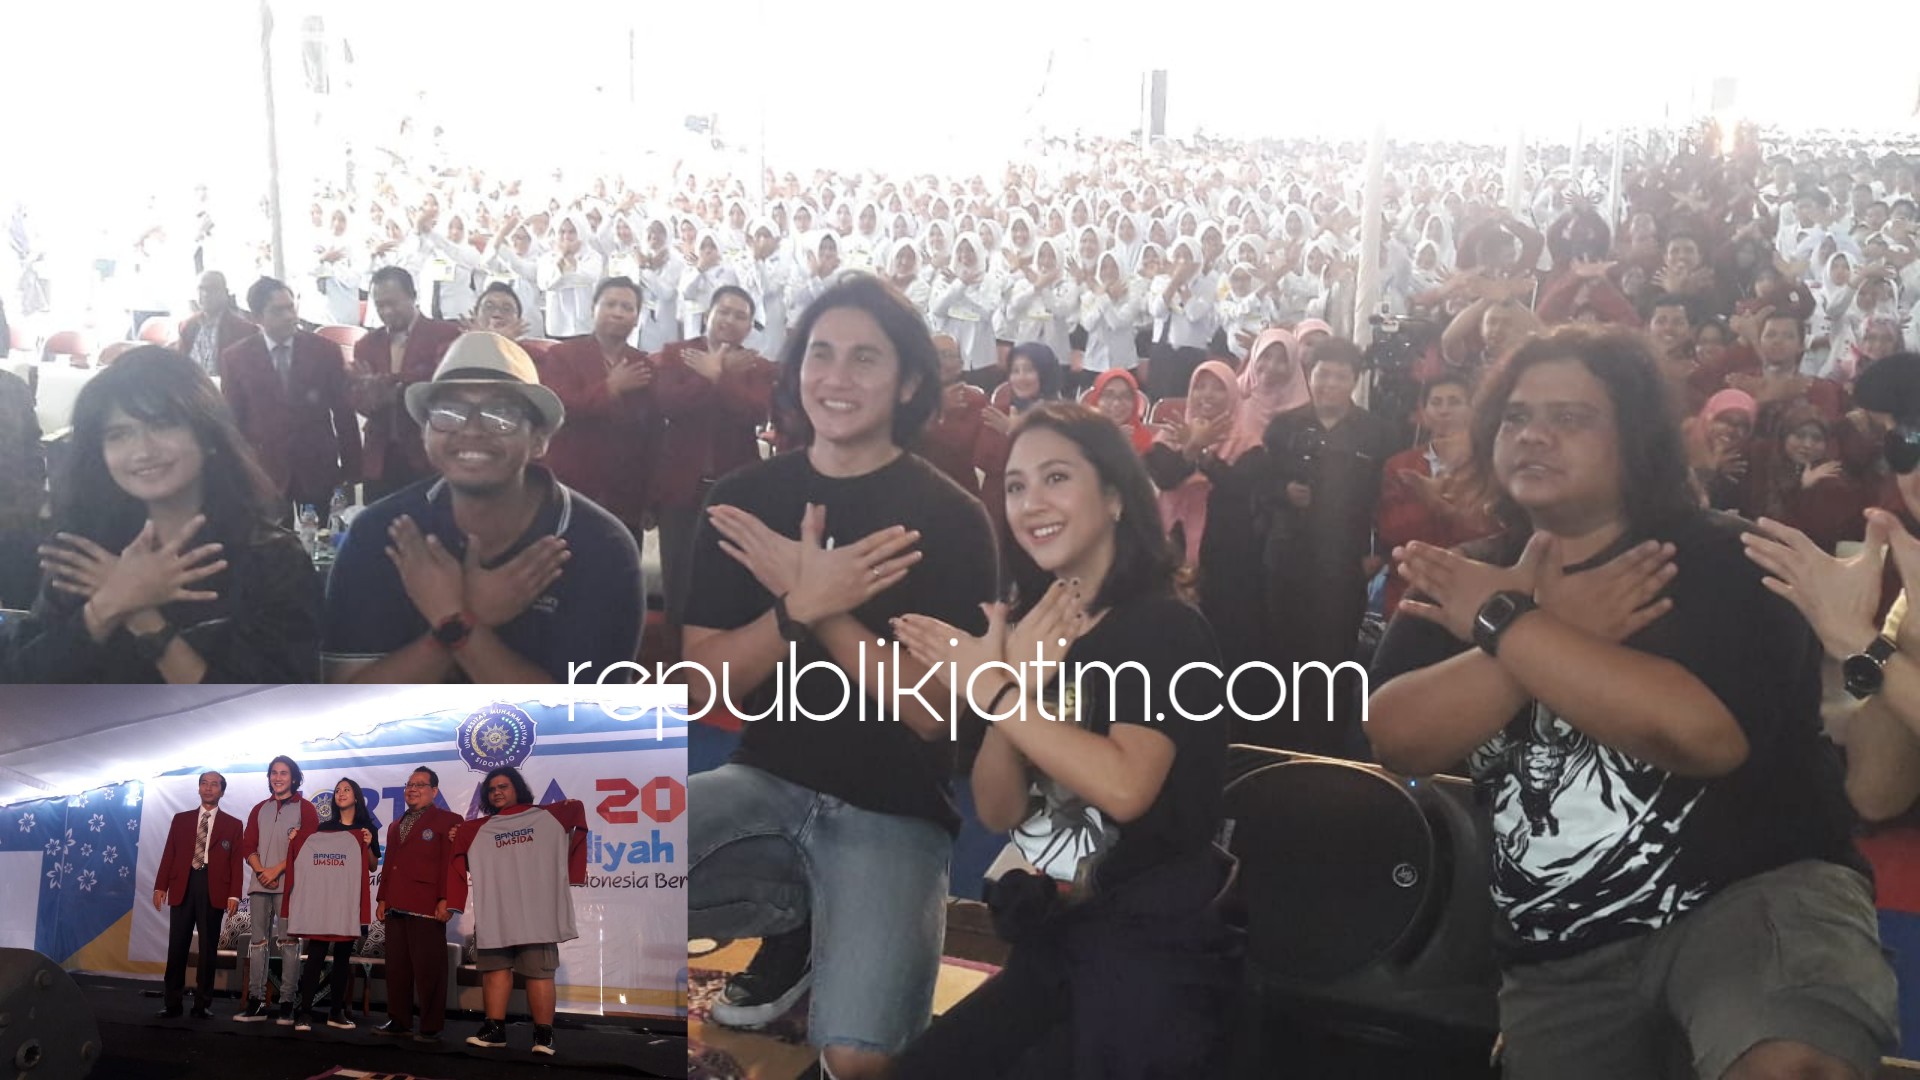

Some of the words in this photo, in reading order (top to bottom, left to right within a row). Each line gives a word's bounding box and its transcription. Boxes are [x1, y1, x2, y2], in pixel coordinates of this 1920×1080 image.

[464, 711, 487, 749] UNIVERSITAS
[490, 708, 529, 746] MUHAMMADIYAH
[475, 755, 515, 768] SIDOARJO
[495, 835, 534, 848] UMSIDA
[313, 859, 345, 867] UMSIDA
